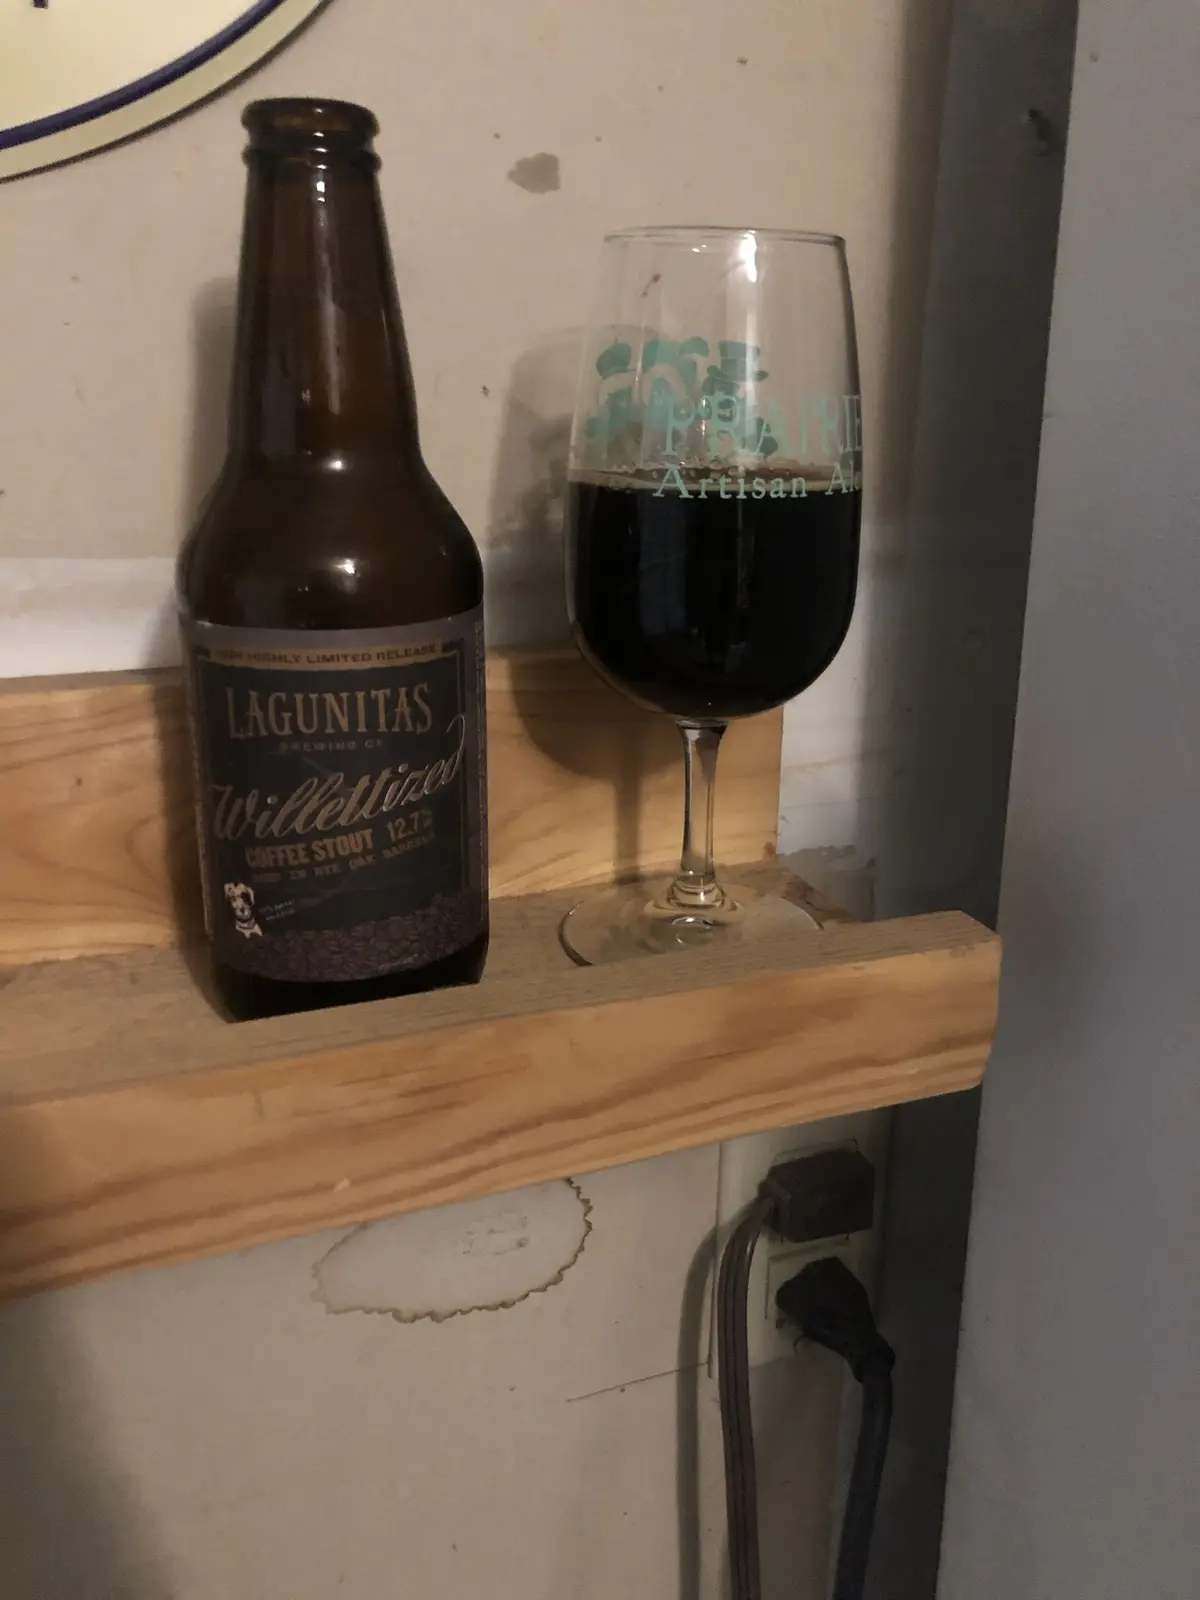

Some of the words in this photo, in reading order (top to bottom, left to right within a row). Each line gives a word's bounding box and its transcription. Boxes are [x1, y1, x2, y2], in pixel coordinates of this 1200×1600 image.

[652, 463, 808, 500] Artisan
[247, 651, 301, 664] HIGHLY
[306, 652, 372, 664] LIMITED
[376, 643, 438, 661] RELEASE
[225, 681, 433, 740] LAGUNITAS
[211, 714, 465, 841] Willettized
[244, 841, 309, 868] COFFEE
[311, 829, 374, 862] STOUT
